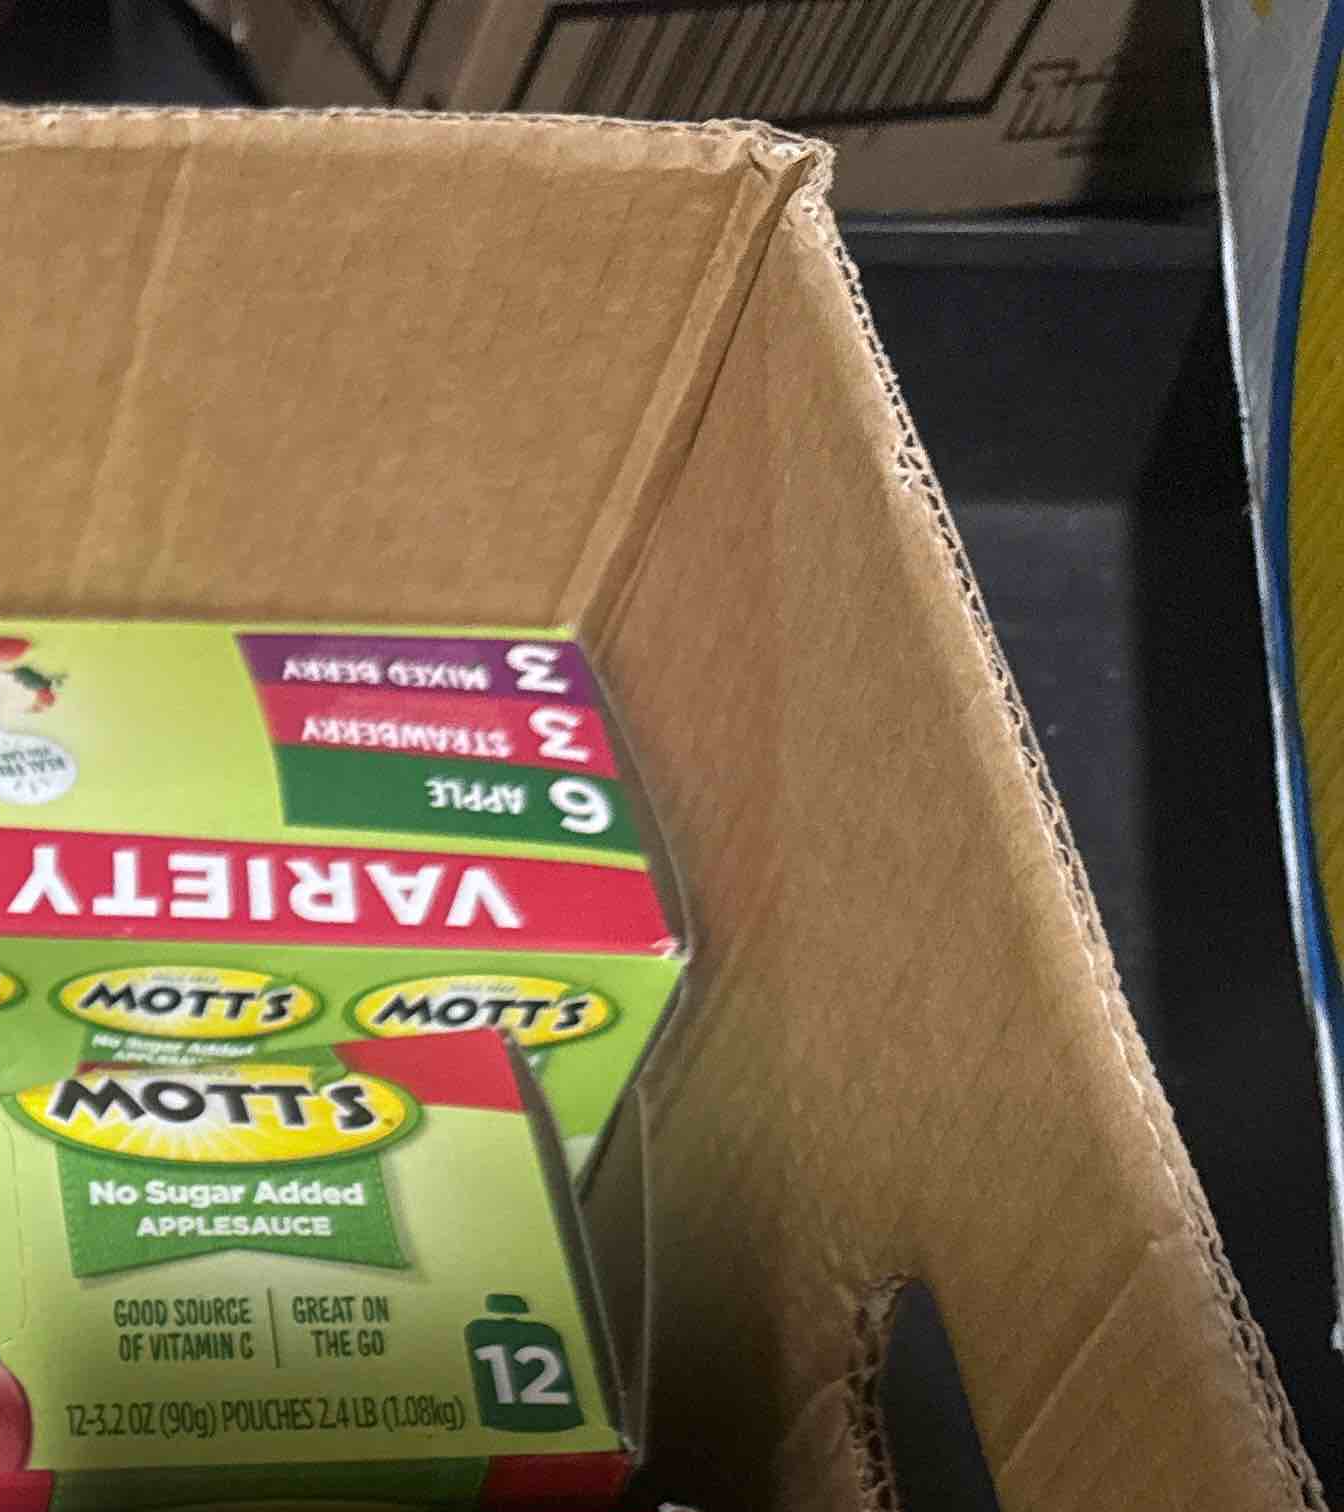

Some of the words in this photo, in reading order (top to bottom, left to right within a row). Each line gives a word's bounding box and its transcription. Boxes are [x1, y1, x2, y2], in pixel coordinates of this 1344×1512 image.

[283, 656, 382, 684] BERRY
[386, 658, 490, 691] MIXED
[507, 644, 569, 694] 3
[302, 715, 515, 758] STRAWBERRY
[528, 708, 592, 762] 3
[427, 776, 527, 816] APPLE
[548, 776, 612, 834] 6
[8, 844, 523, 928] VARIETY
[77, 983, 293, 1022] MOTT'S
[372, 991, 588, 1030] MOTT'S
[50, 1077, 377, 1133] MOTT'S
[88, 1180, 137, 1207] No
[143, 1180, 245, 1212] Sugar
[253, 1179, 366, 1207] Added
[136, 1215, 333, 1239] APPLESAUCE
[476, 1345, 570, 1406] 12
